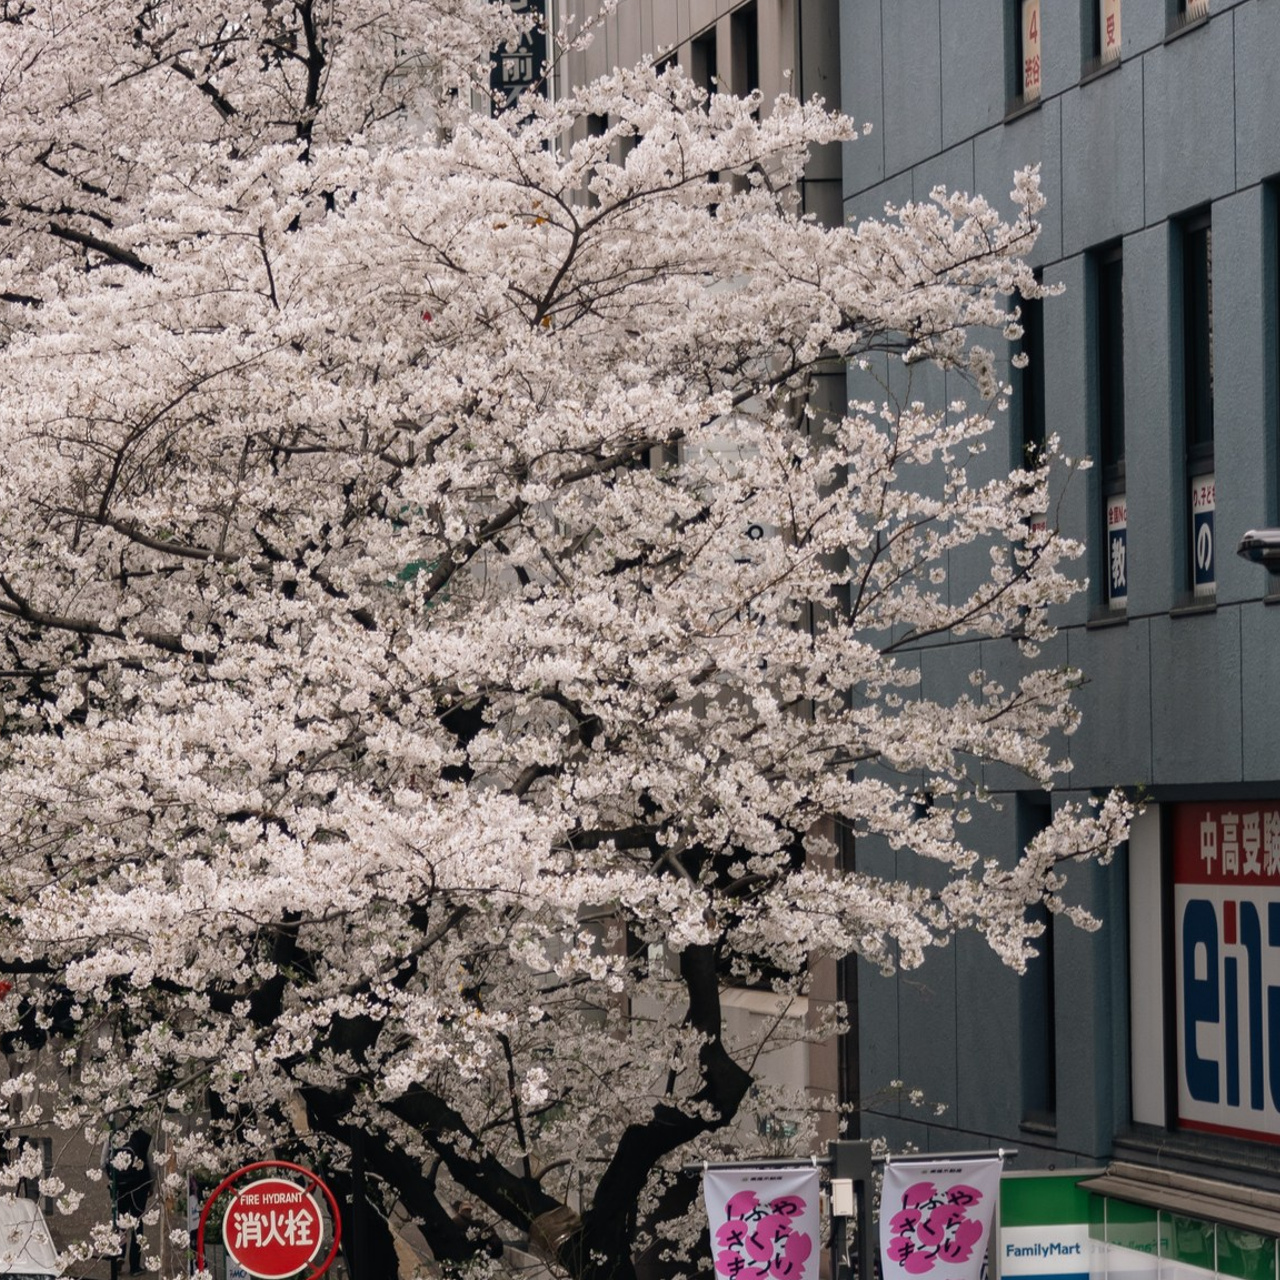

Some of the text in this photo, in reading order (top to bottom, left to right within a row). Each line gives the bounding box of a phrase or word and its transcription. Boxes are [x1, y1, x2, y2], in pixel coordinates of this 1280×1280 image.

[1197, 522, 1212, 571] の
[1200, 810, 1280, 877] 中高受験
[240, 1192, 302, 1205] FIRE HYDRANT
[726, 1200, 798, 1222] しぶや
[902, 1190, 974, 1210] しぶや
[233, 1208, 313, 1249] 消火栓
[726, 1224, 790, 1251] さくら
[900, 1213, 962, 1239] さくら
[898, 1239, 962, 1267] まつり
[1006, 1242, 1081, 1258] FamilyMart
